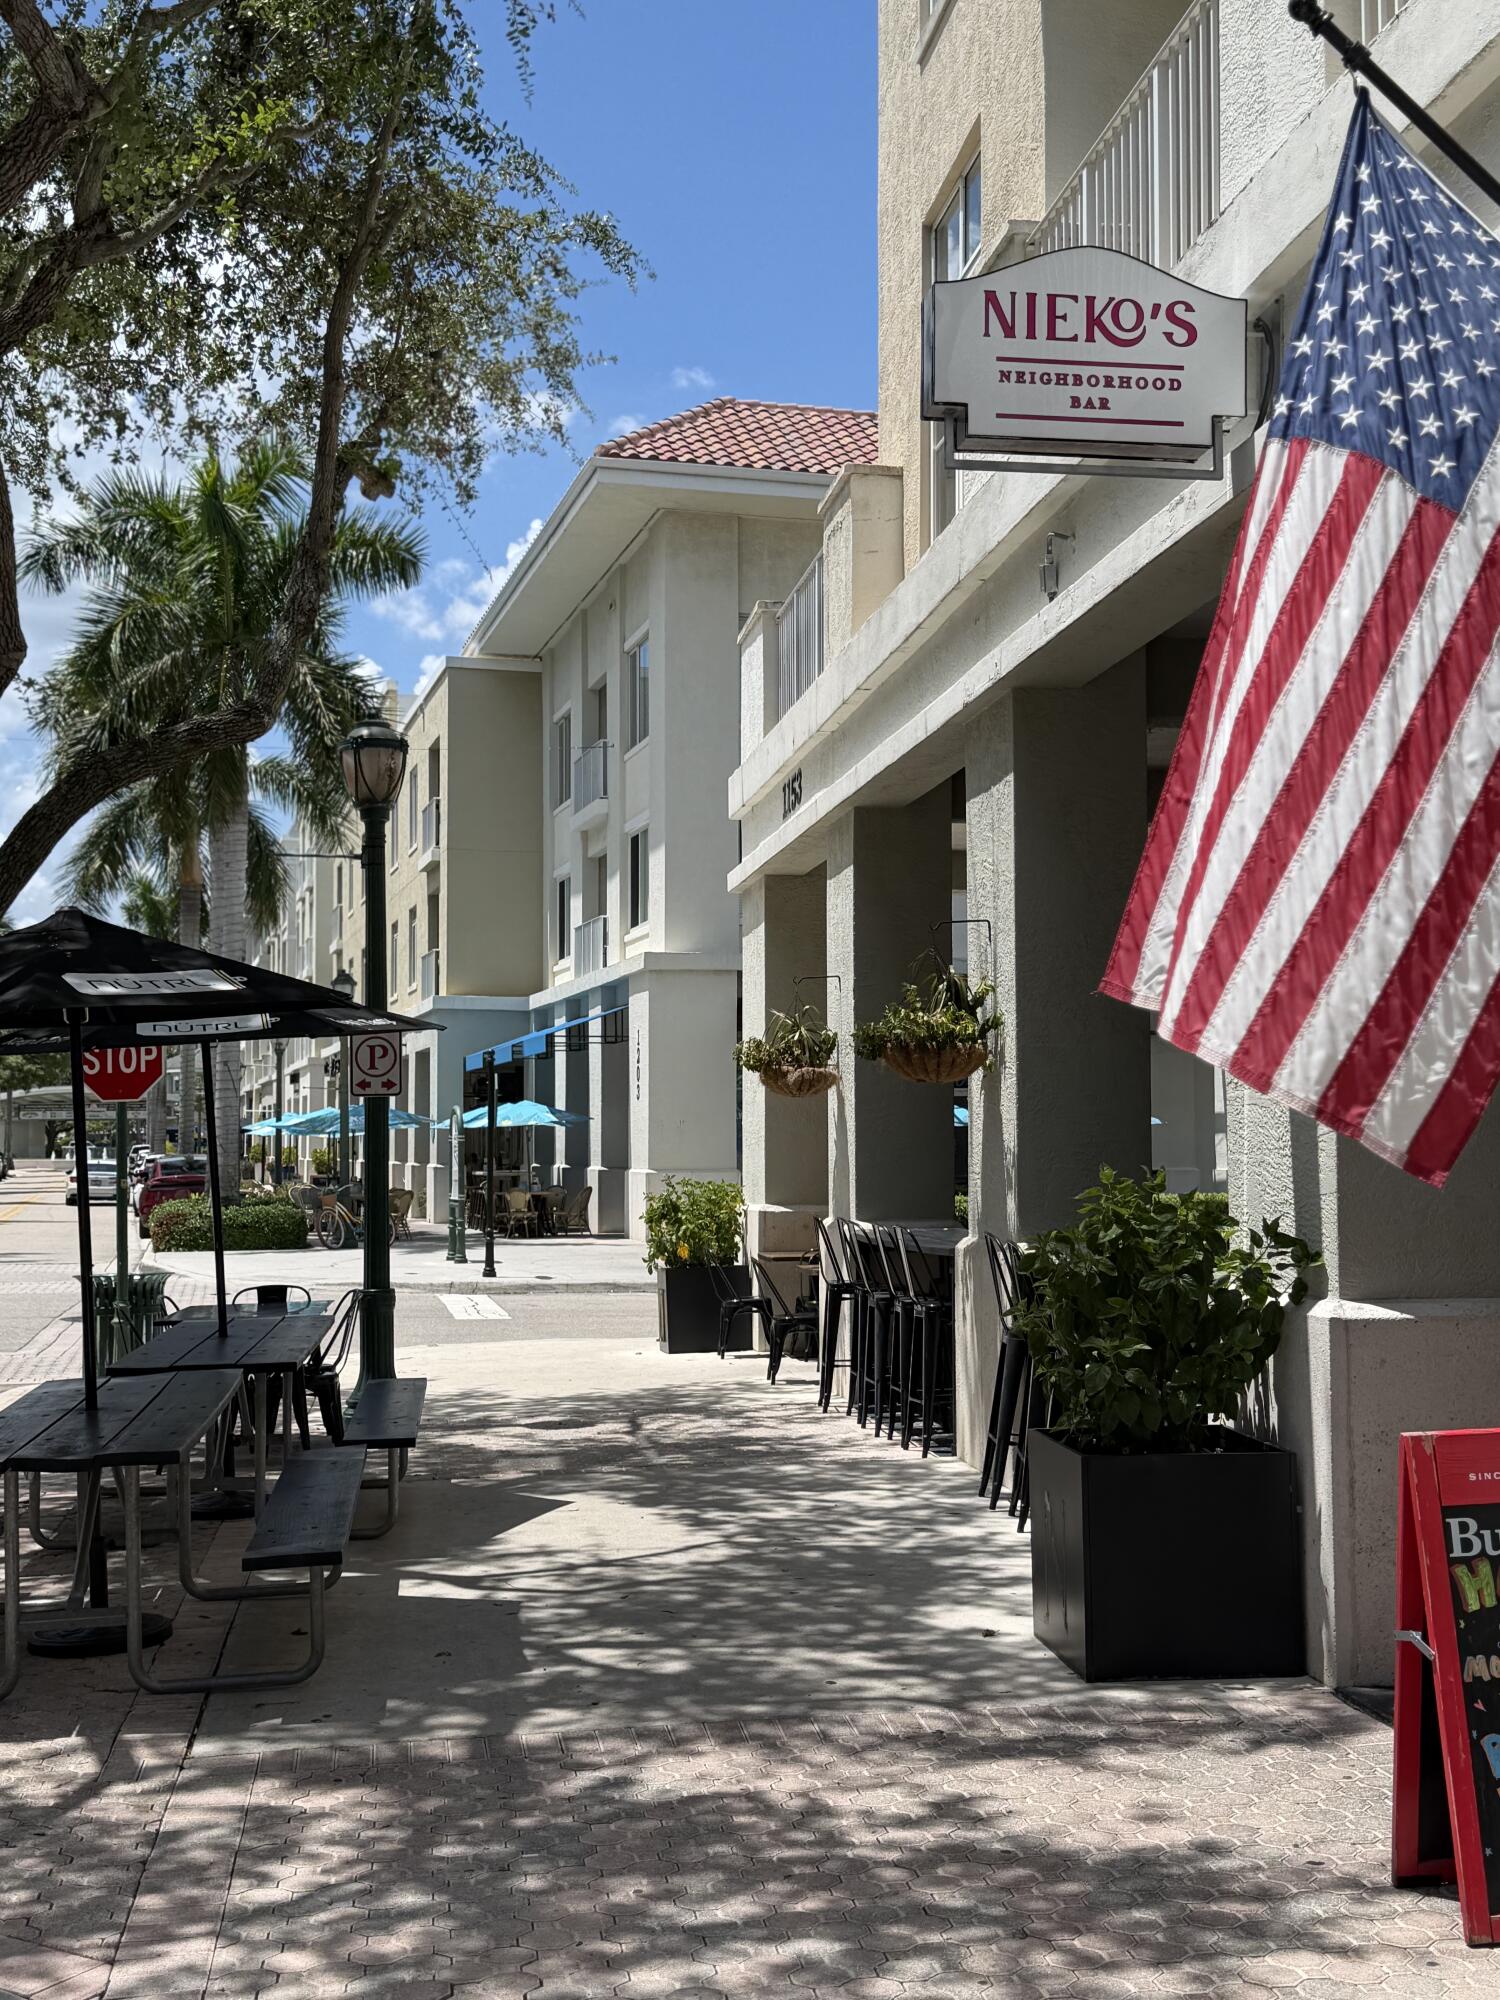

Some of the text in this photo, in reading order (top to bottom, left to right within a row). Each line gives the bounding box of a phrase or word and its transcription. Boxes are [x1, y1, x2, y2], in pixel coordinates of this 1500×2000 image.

[982, 289, 1198, 348] NIEKO'S
[998, 370, 1182, 392] NEIGHBORHOOD
[1069, 395, 1111, 411] BAR
[83, 1046, 158, 1075] STOP
[366, 1044, 389, 1071] P
